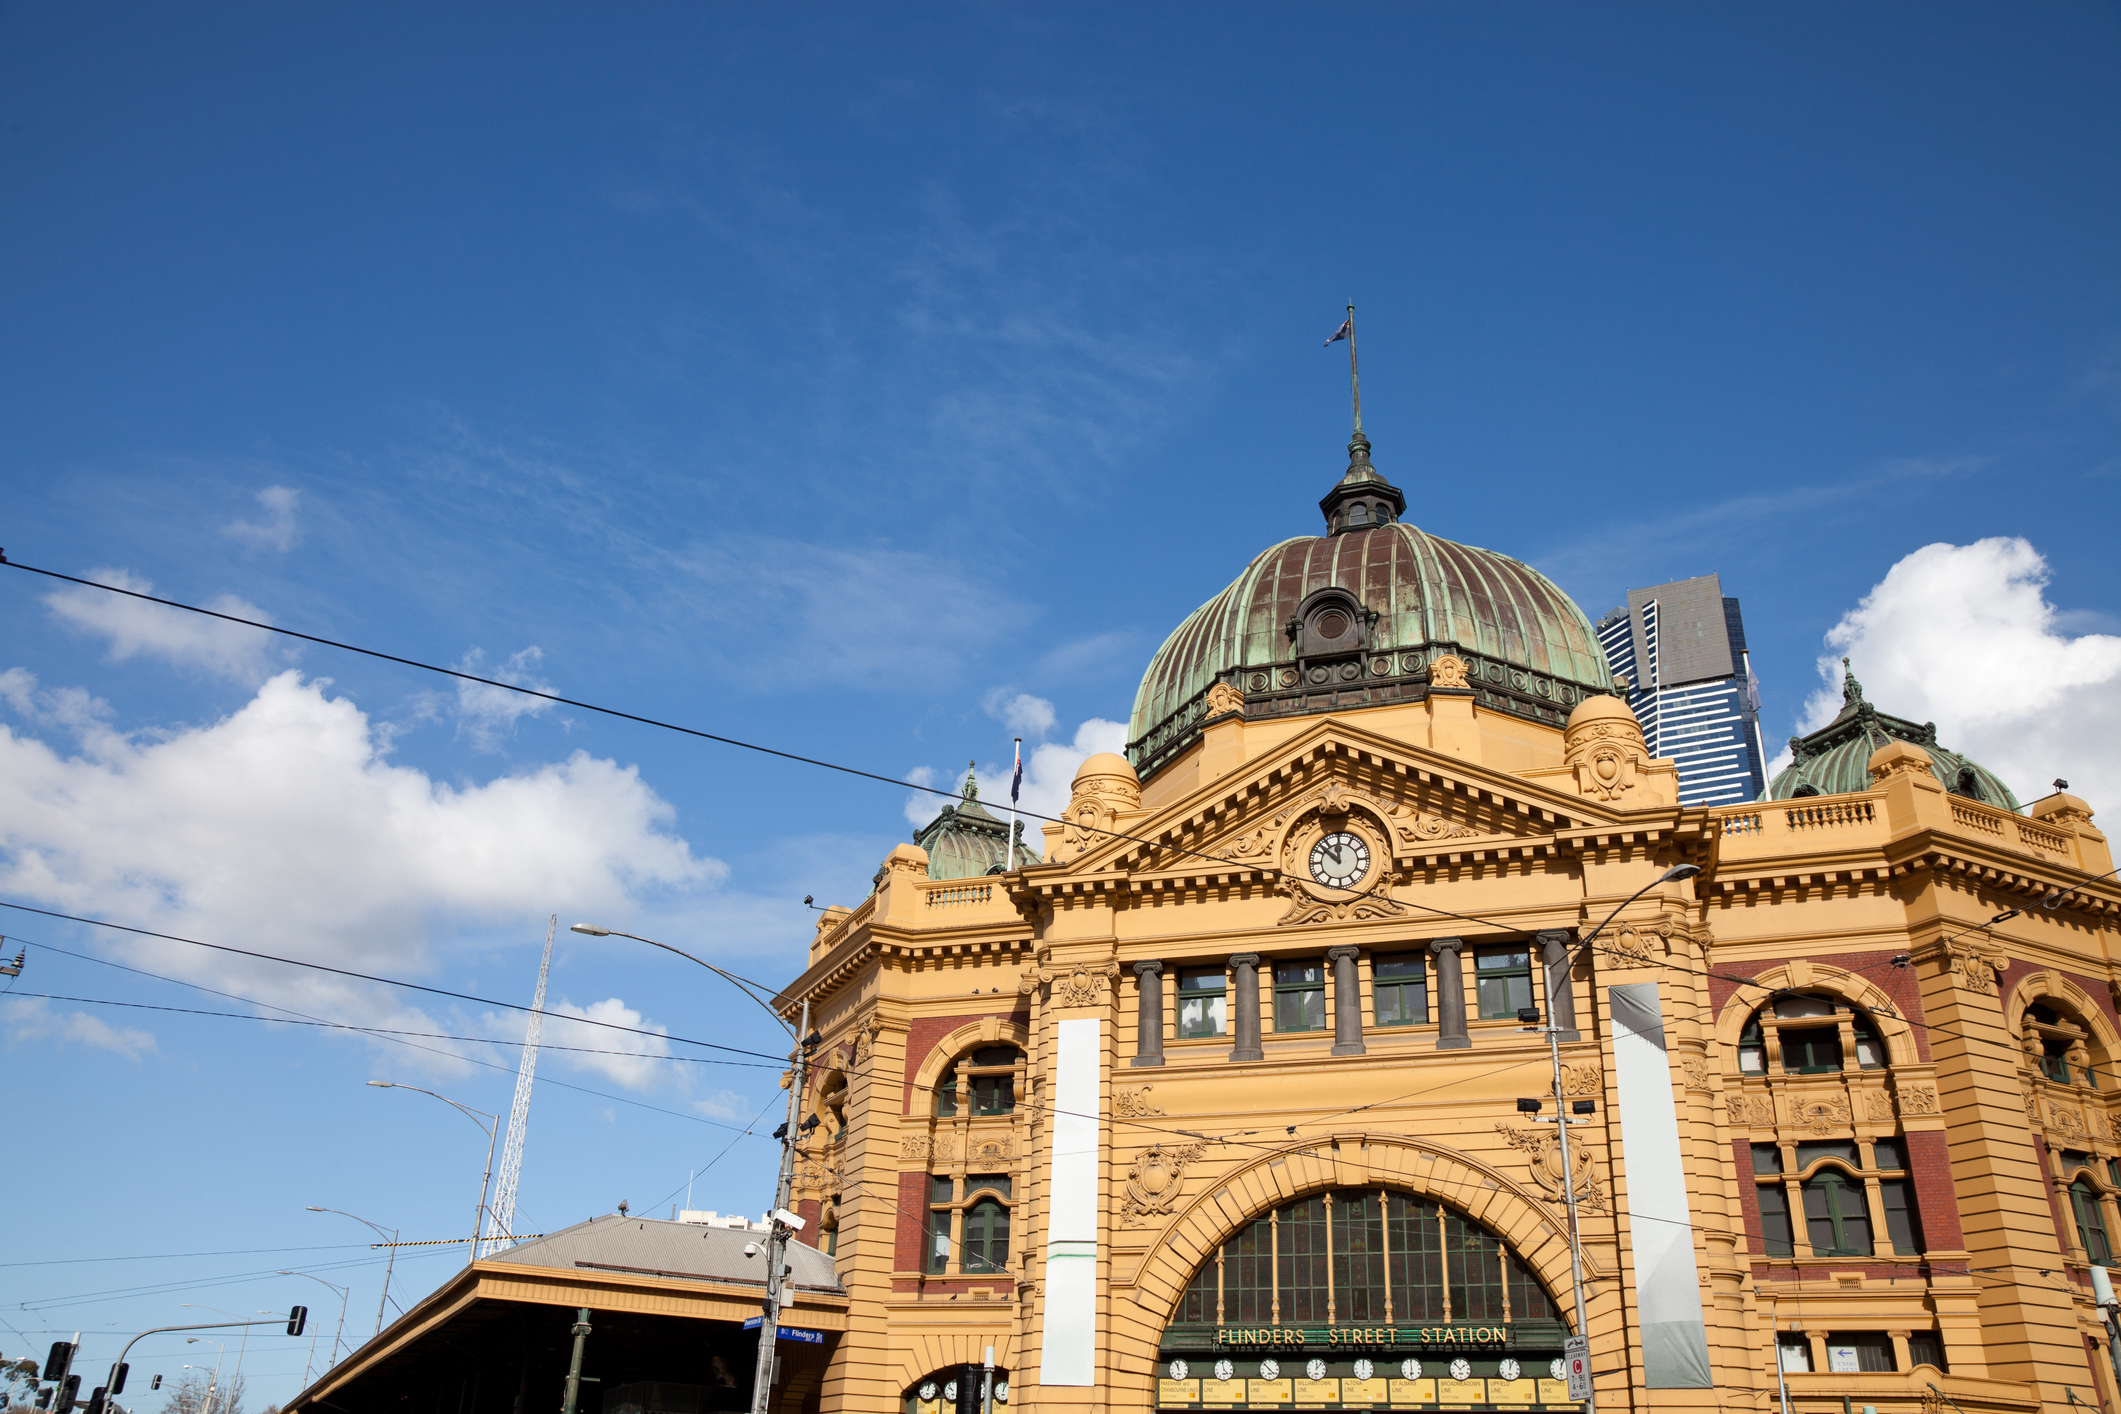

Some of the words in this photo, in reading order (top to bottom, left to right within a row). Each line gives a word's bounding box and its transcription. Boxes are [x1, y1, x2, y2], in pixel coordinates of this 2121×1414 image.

[792, 1329, 814, 1338] Flinders
[1218, 1329, 1305, 1344] FLINDERS
[1329, 1328, 1398, 1344] STREET
[1421, 1327, 1507, 1343] STATION
[1574, 1361, 1580, 1373] C
